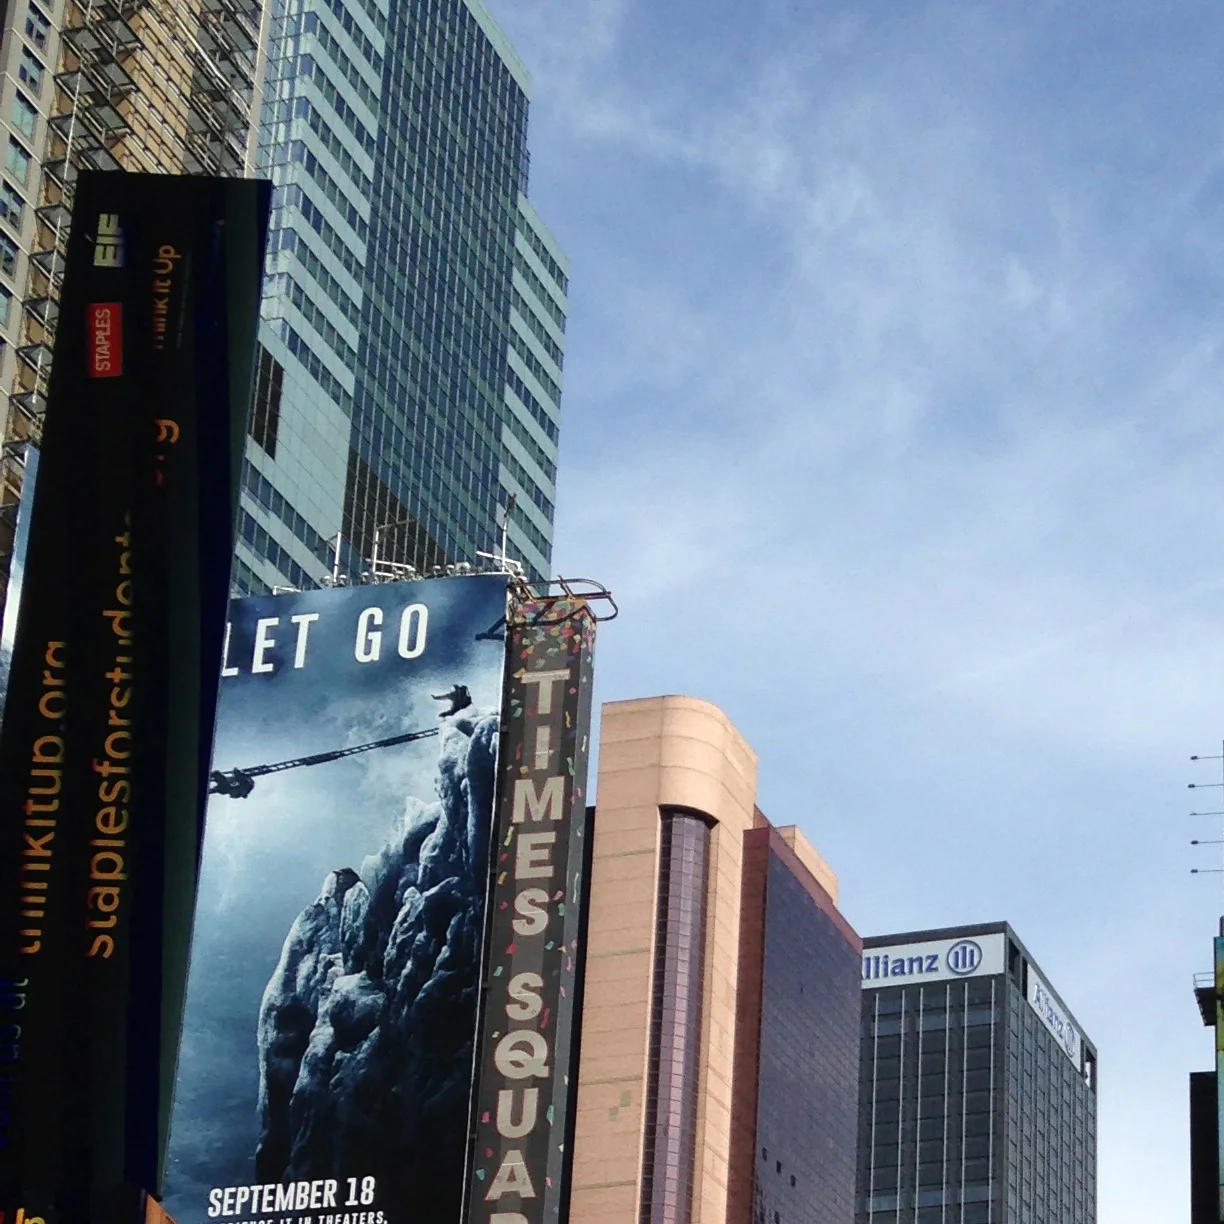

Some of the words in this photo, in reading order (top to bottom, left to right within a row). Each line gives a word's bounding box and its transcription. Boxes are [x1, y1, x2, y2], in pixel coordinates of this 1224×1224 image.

[95, 308, 111, 371] STAPLES
[221, 613, 320, 677] LET
[354, 603, 429, 663] GO
[511, 669, 571, 936] TIMES
[862, 954, 939, 980] llianz
[208, 1178, 337, 1218] SEPTEMBER
[344, 1175, 376, 1207] 18
